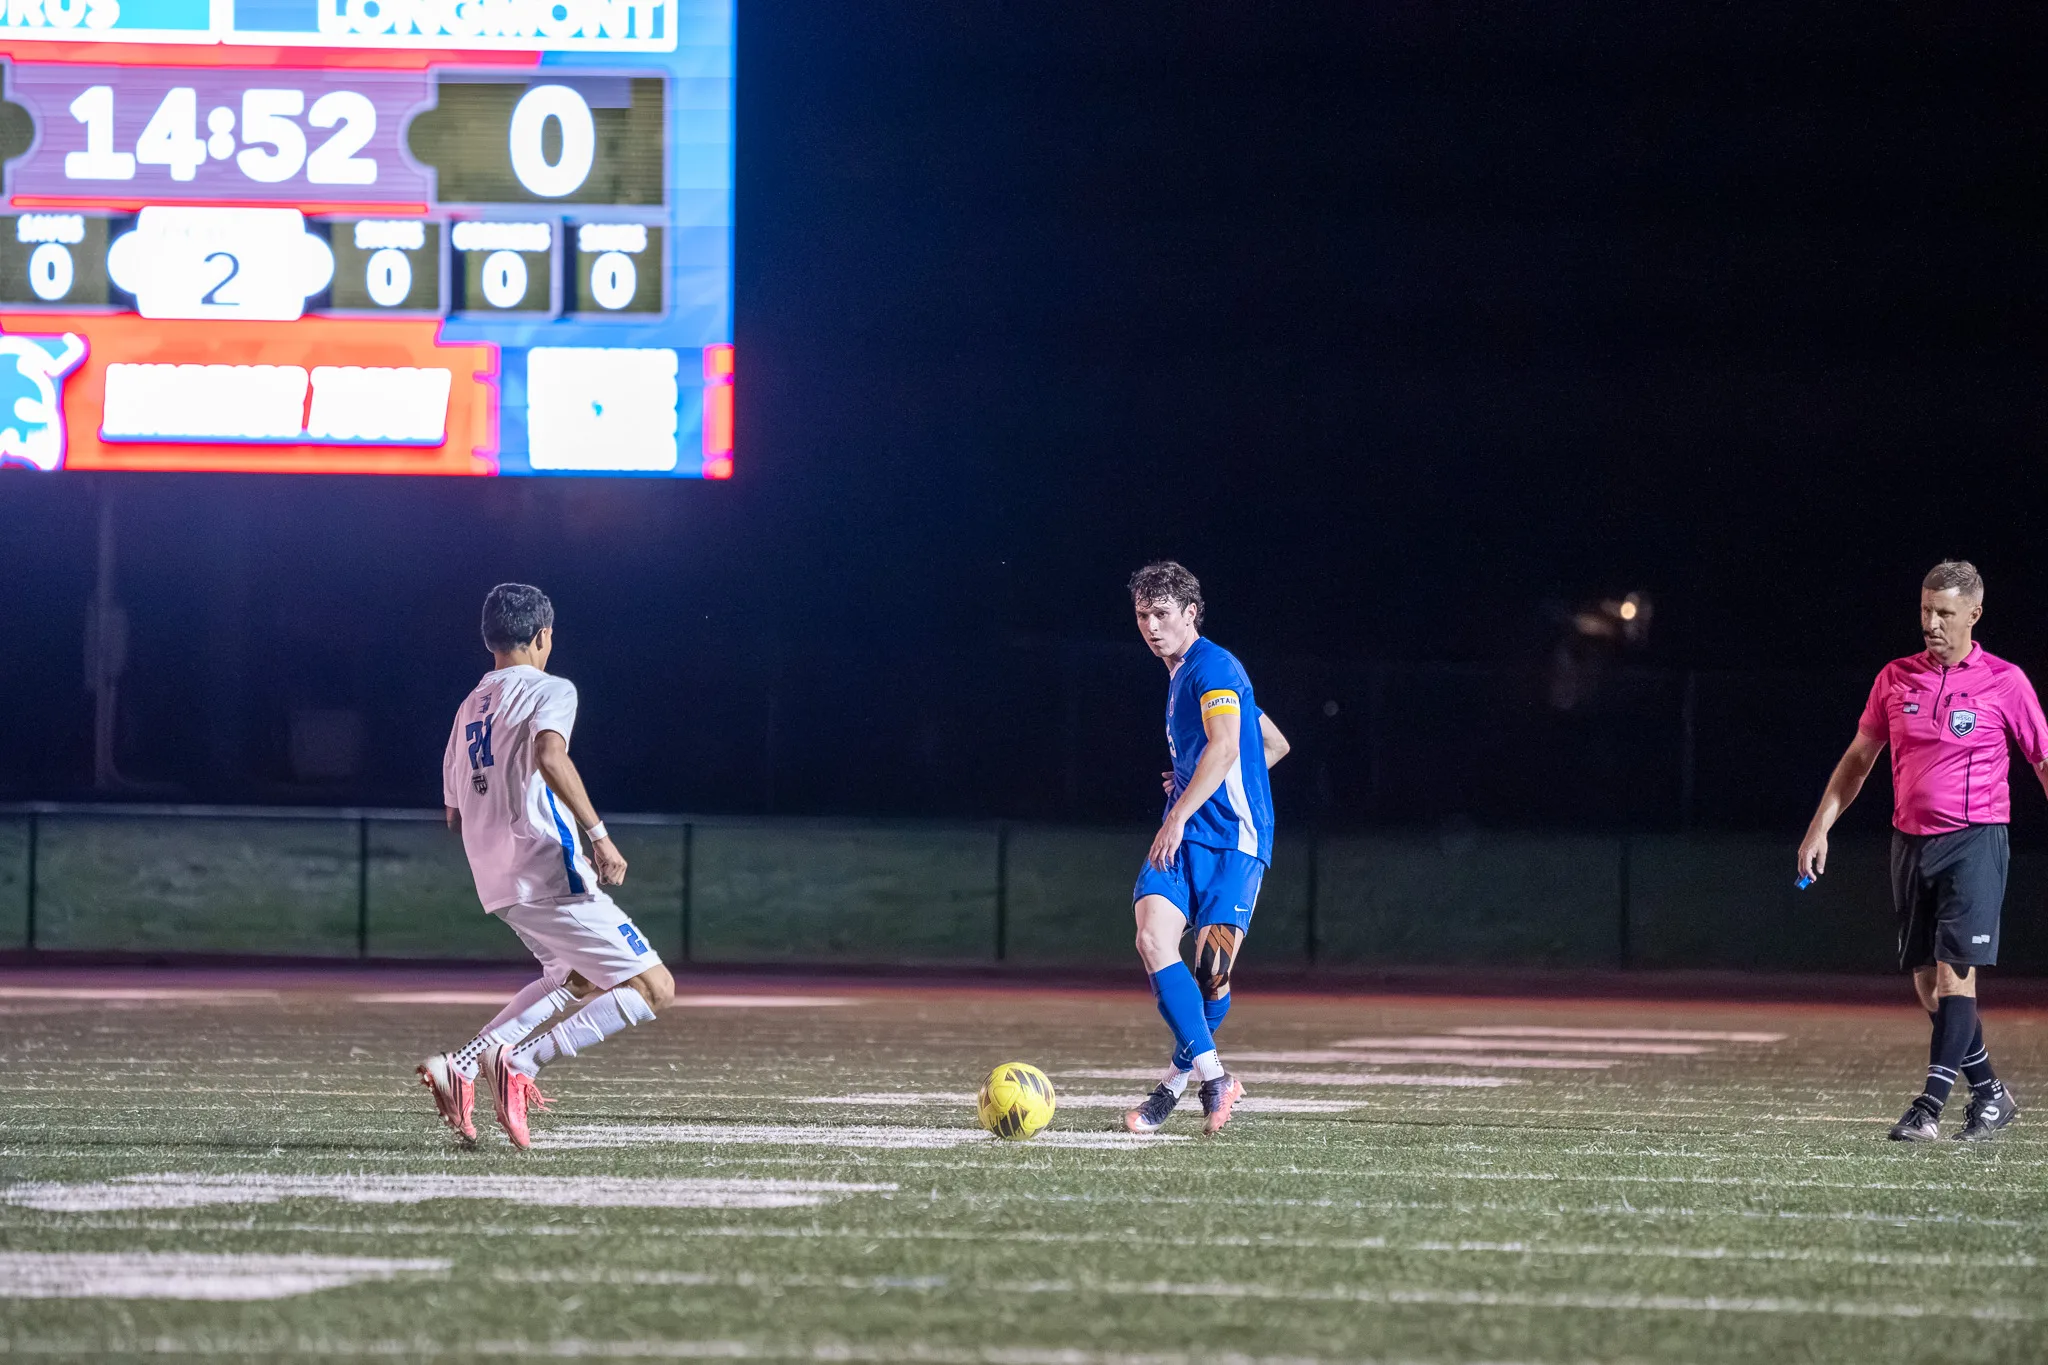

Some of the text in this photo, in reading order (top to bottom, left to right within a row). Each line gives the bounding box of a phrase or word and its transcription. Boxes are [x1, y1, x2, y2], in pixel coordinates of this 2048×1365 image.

[65, 85, 378, 184] 14:52
[510, 84, 596, 197] 0
[28, 242, 74, 301] 0
[201, 252, 240, 306] 2
[366, 249, 411, 307] 0
[482, 250, 528, 308] 0
[591, 251, 637, 310] 0
[1207, 697, 1238, 709] CAPTAIN
[465, 713, 495, 770] 21
